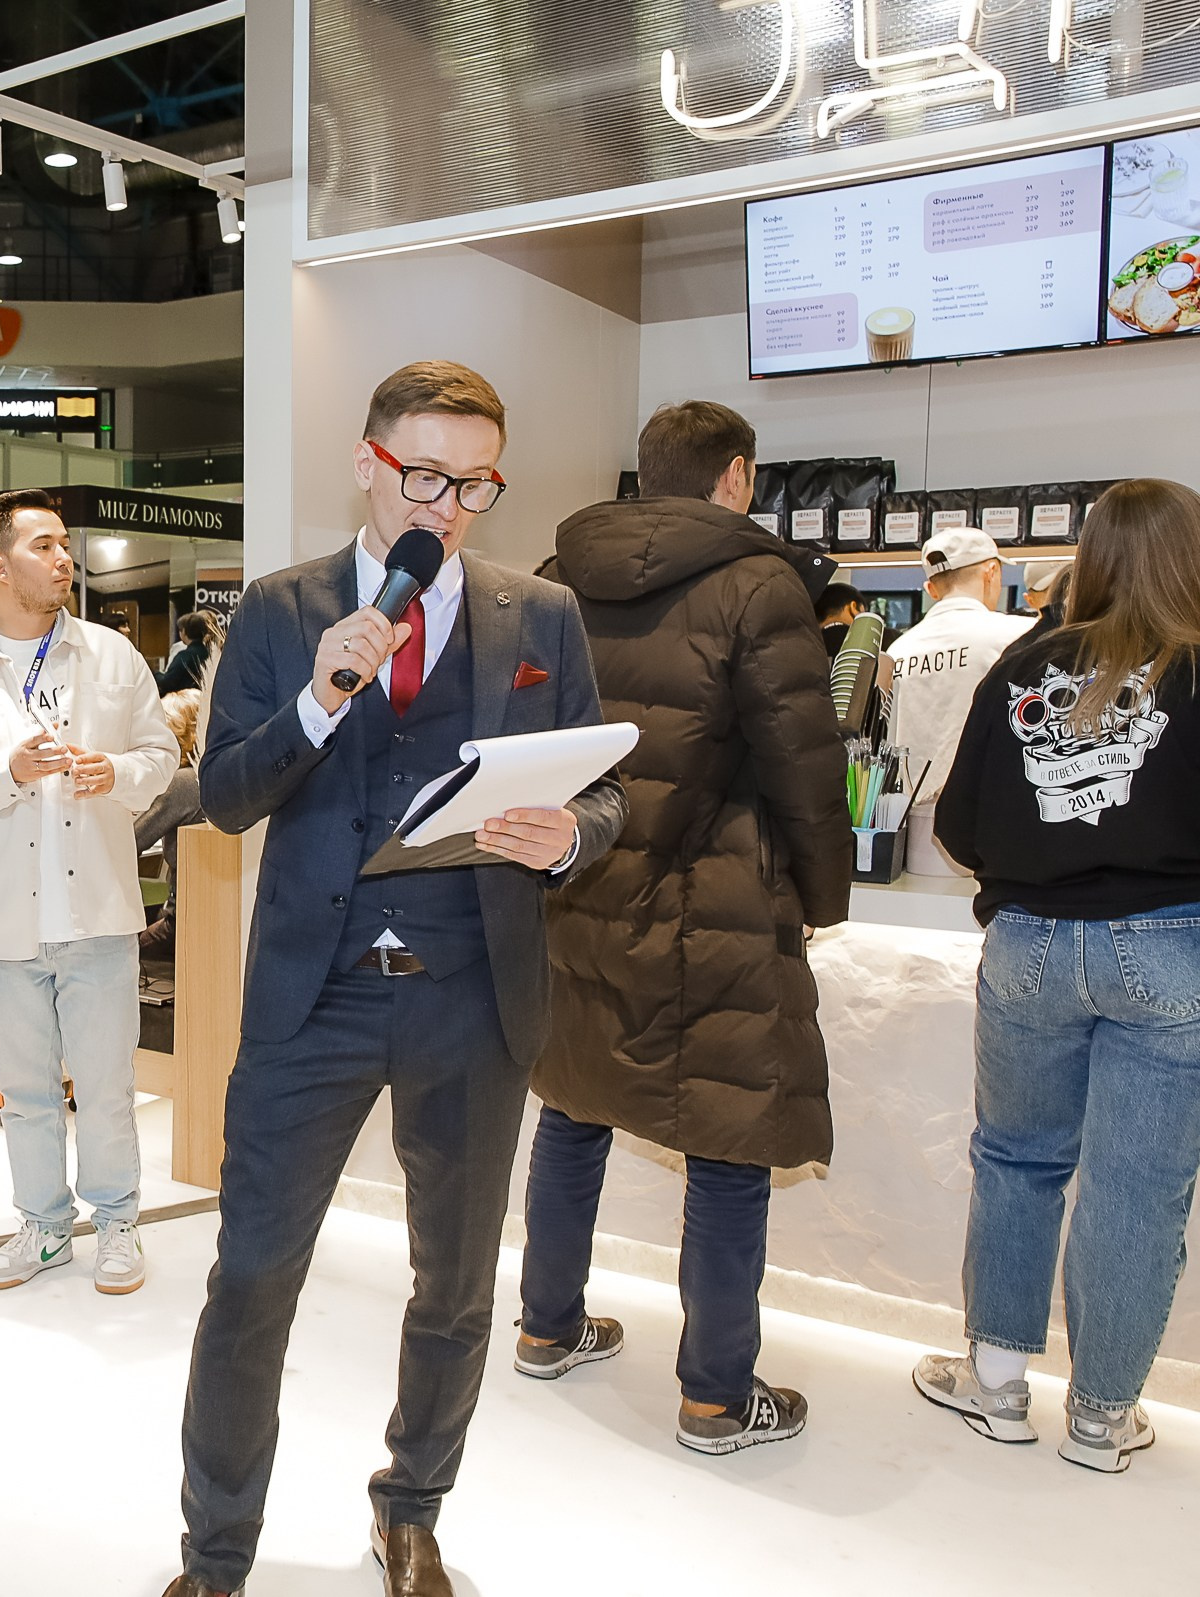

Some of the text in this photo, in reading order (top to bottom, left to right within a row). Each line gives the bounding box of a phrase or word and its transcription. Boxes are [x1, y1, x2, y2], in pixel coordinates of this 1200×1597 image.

[933, 193, 984, 205] Фирменные
[976, 203, 994, 211] латте
[1060, 189, 1075, 197] 299
[763, 215, 783, 223] Кофе
[932, 219, 946, 228] раф
[981, 209, 1014, 220] арахисом
[1060, 200, 1075, 208] 369
[932, 229, 946, 237] раф
[1025, 215, 1039, 223] 329
[932, 238, 946, 247] раф
[1059, 220, 1074, 228] 369
[932, 275, 949, 283] Чай
[766, 303, 824, 316] Сделай вкуснее
[1040, 302, 1054, 310] 369
[98, 500, 223, 529] MIUZ DIAMONDS
[196, 588, 242, 607] Откр
[1041, 753, 1131, 781] В ОТВЕТЕ ЗА СТИЛЬ
[1060, 803, 1067, 814] С
[1068, 789, 1106, 812] 2014
